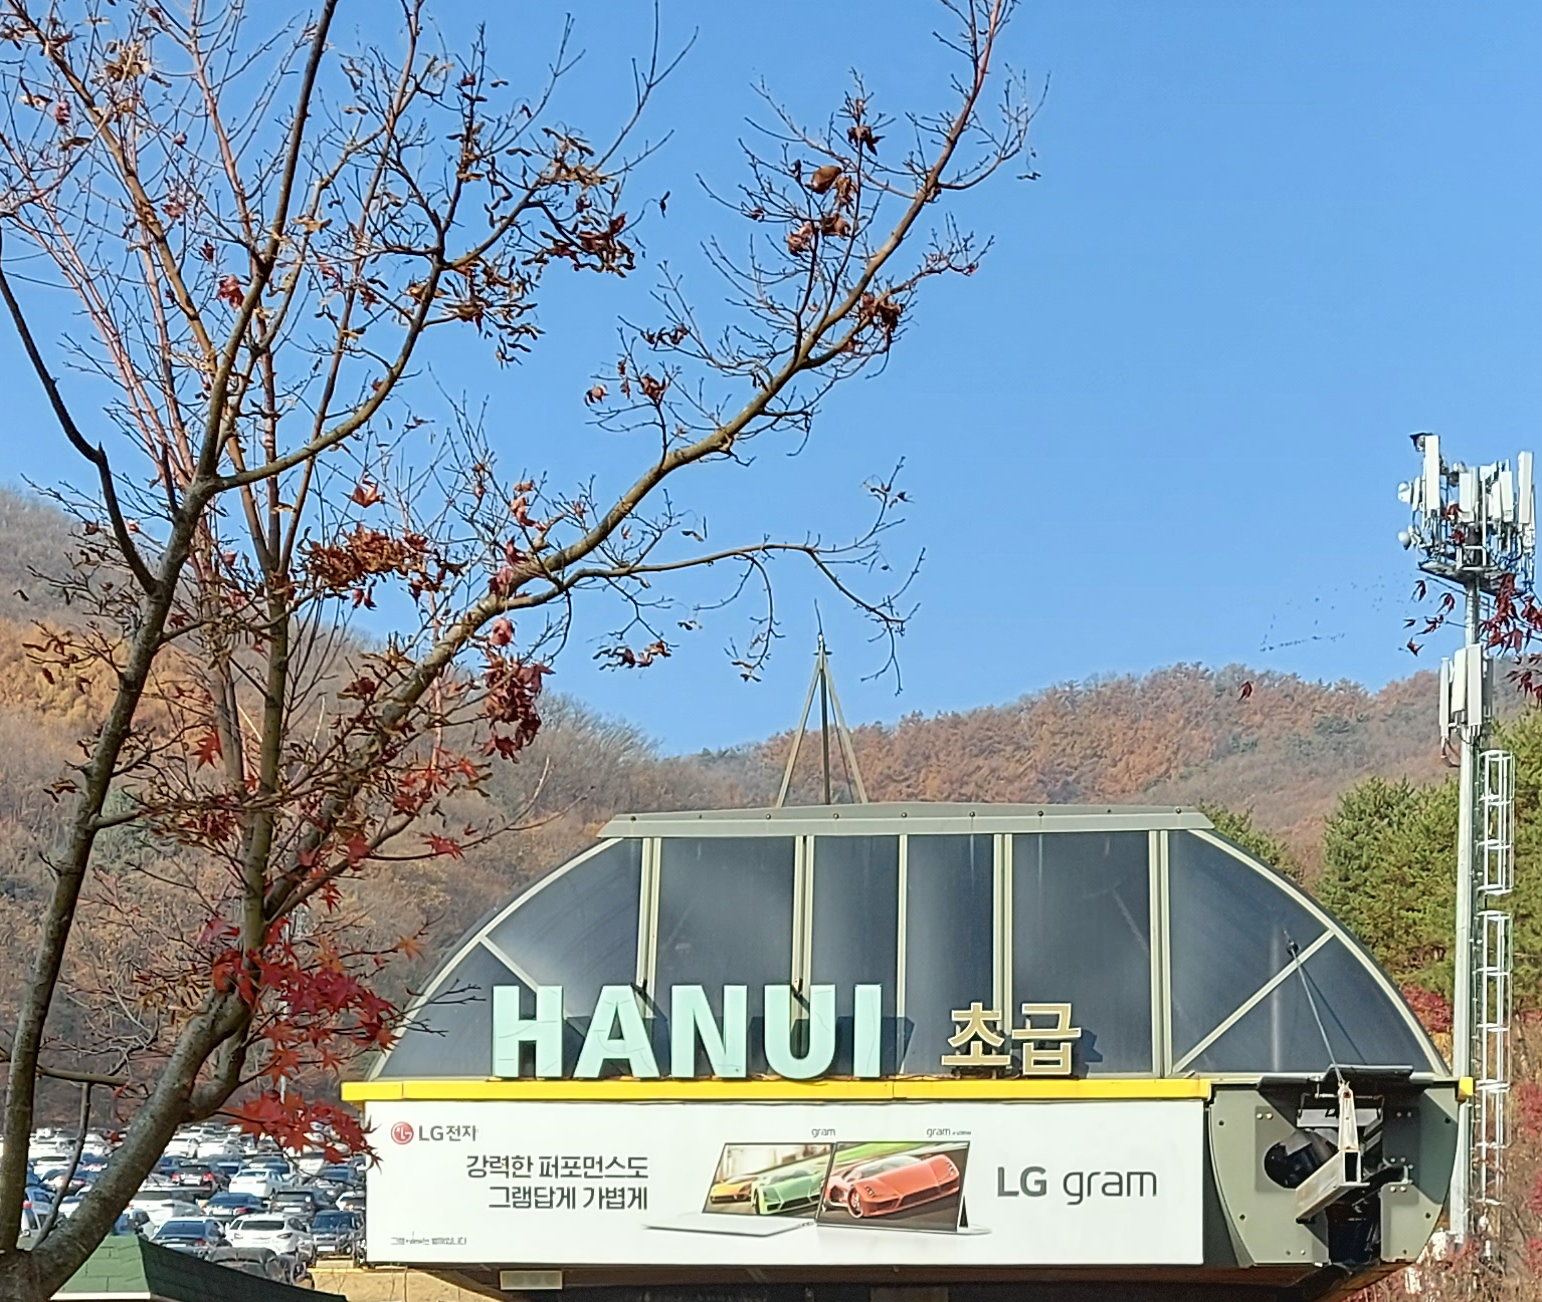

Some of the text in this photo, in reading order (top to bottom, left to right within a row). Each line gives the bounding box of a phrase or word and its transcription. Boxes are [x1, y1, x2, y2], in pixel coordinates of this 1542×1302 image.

[493, 984, 882, 1081] HANUI
[941, 1002, 1083, 1077] 초급
[811, 1127, 836, 1138] gram
[926, 1126, 951, 1138] gram
[466, 1155, 649, 1179] 강력한 퍼포먼스도
[997, 1166, 1157, 1205] LG gram
[489, 1186, 648, 1210] 그램답게 가볍게
